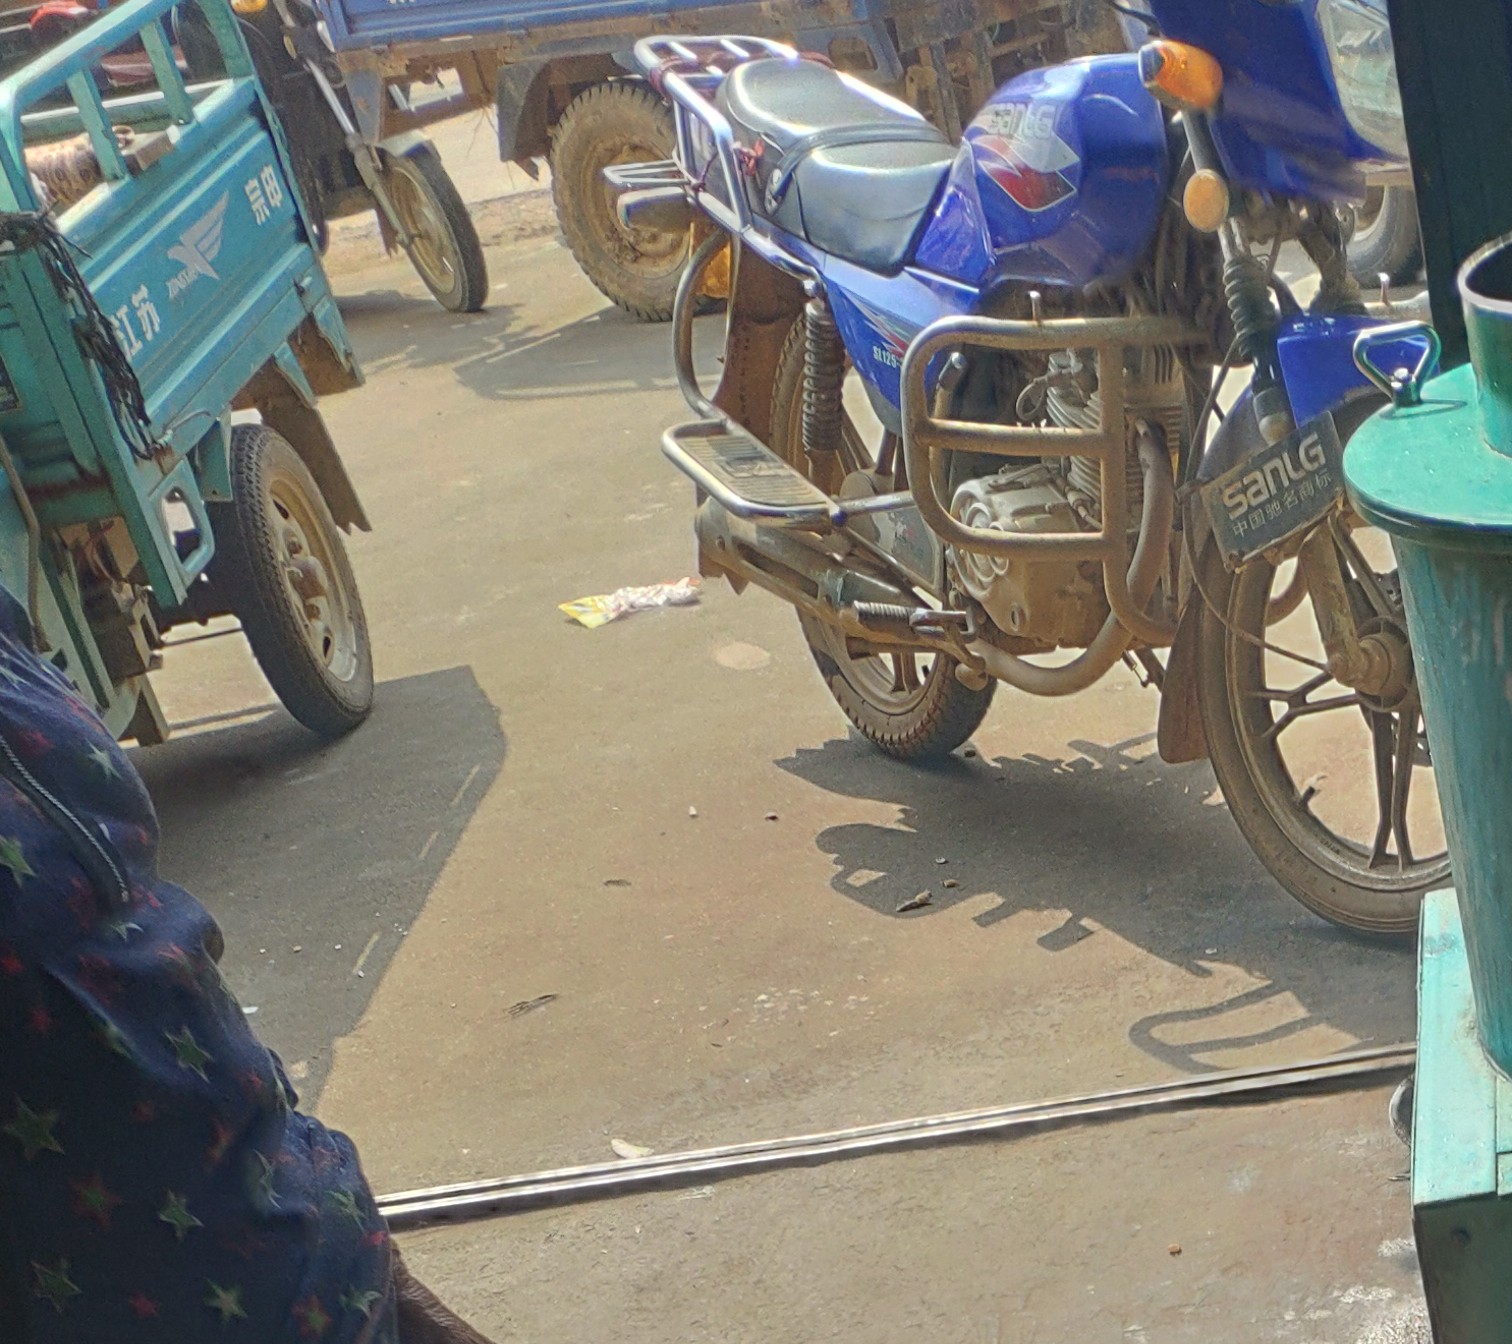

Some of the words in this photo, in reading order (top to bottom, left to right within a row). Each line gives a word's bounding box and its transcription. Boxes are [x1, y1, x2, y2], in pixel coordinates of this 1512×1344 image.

[244, 164, 283, 226] 宗申
[1232, 467, 1332, 537] 中国驰名商标
